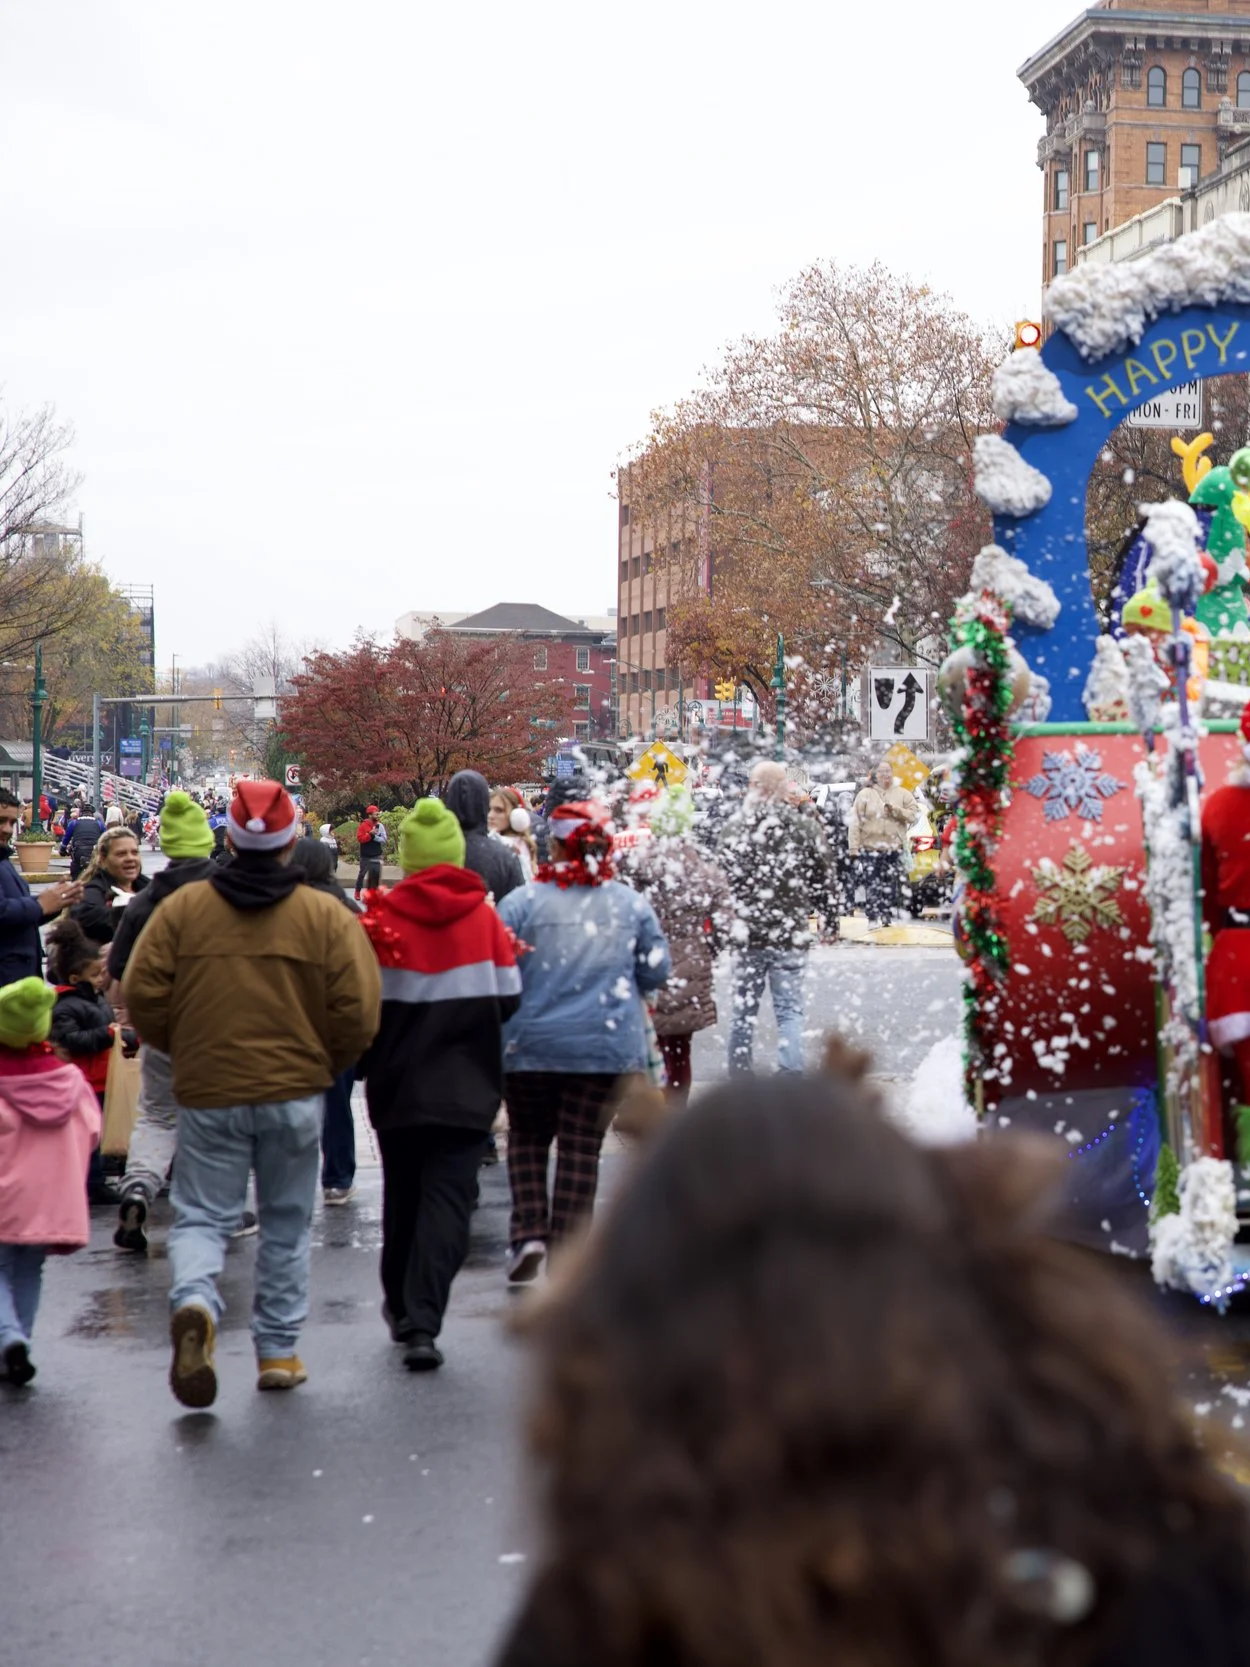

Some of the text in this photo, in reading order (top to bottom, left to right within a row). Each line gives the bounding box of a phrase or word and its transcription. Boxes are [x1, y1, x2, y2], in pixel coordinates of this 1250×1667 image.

[1085, 320, 1240, 419] HAPPY
[1133, 402, 1161, 419] MON
[1175, 403, 1197, 419] FRI
